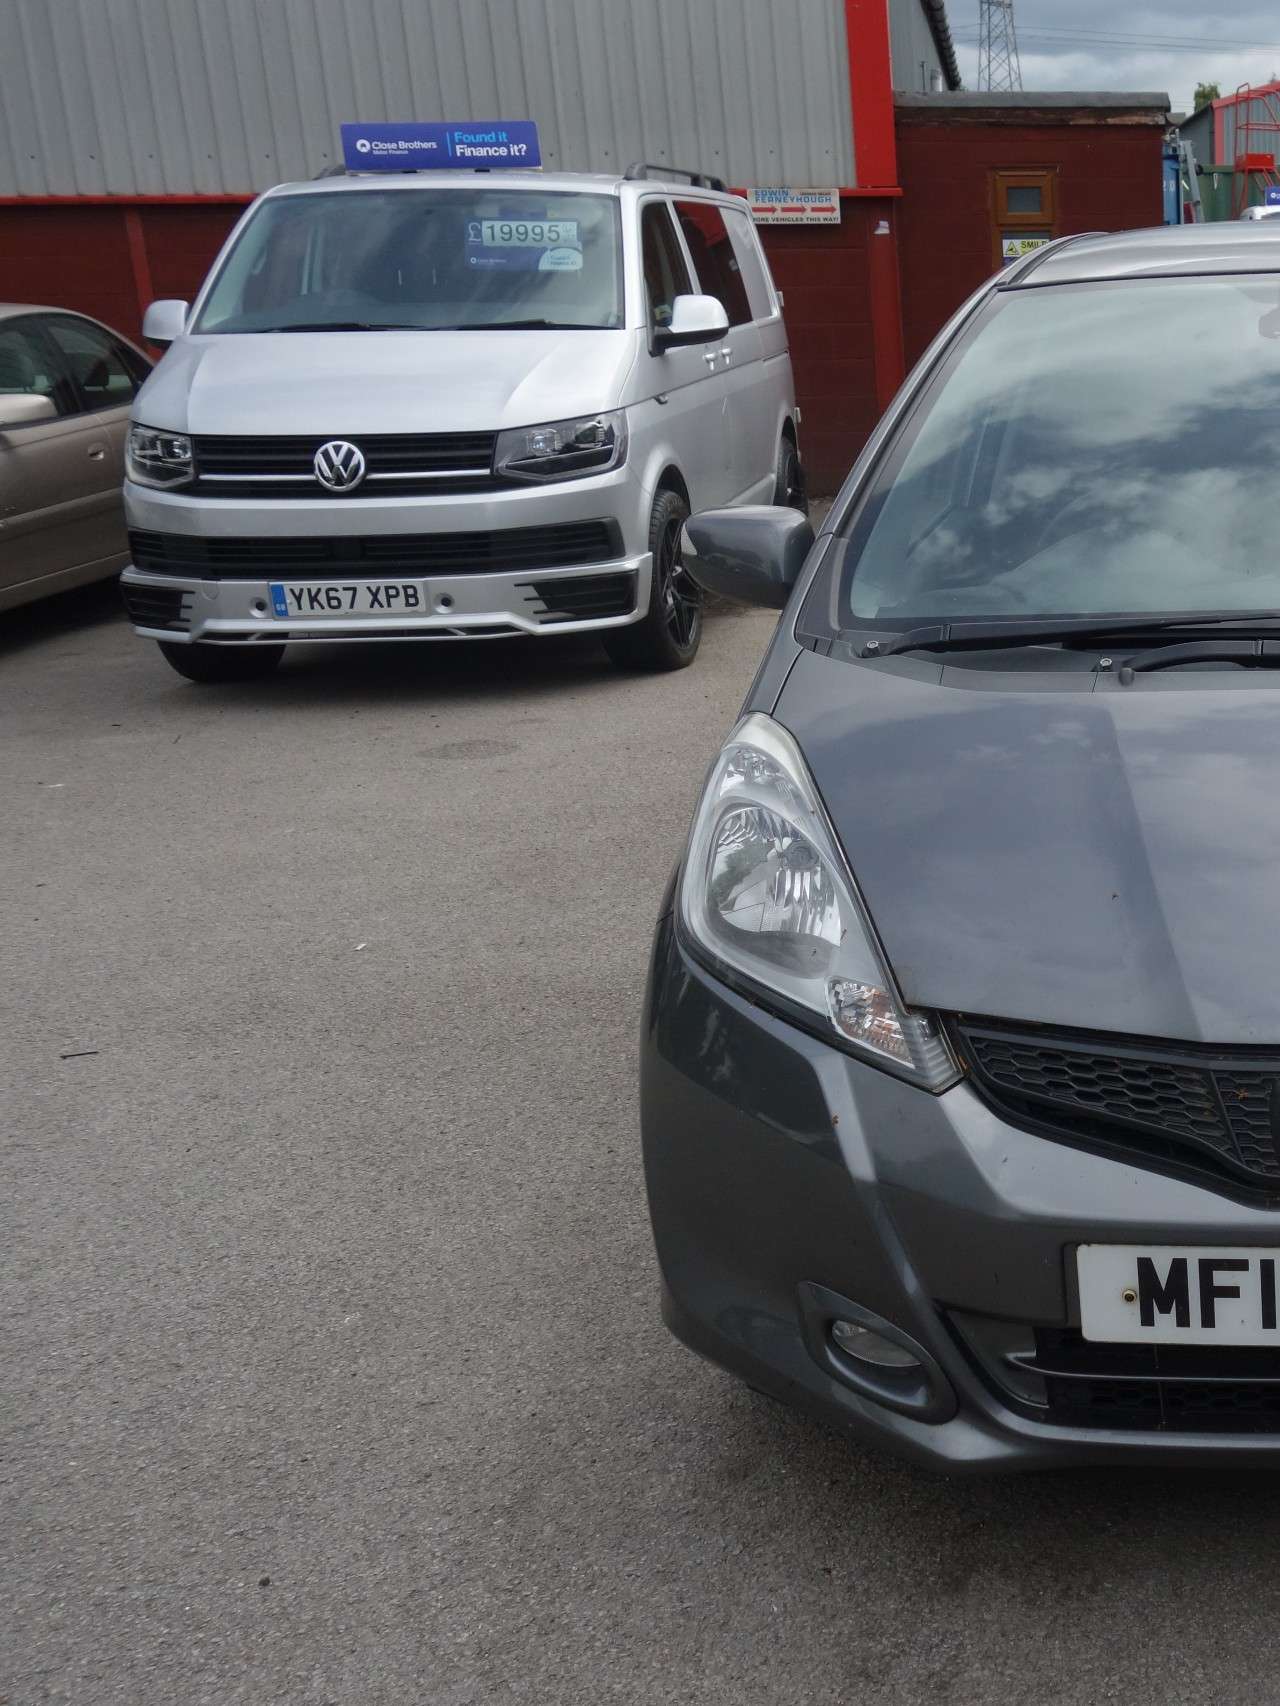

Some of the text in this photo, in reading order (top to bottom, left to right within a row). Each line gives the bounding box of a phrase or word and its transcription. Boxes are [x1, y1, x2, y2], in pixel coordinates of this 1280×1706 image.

[454, 132, 508, 143] Found it
[371, 141, 438, 149] Close Brothers
[456, 143, 527, 157] Finance it?
[486, 223, 560, 242] 19995
[289, 584, 420, 611] YK67 XPB
